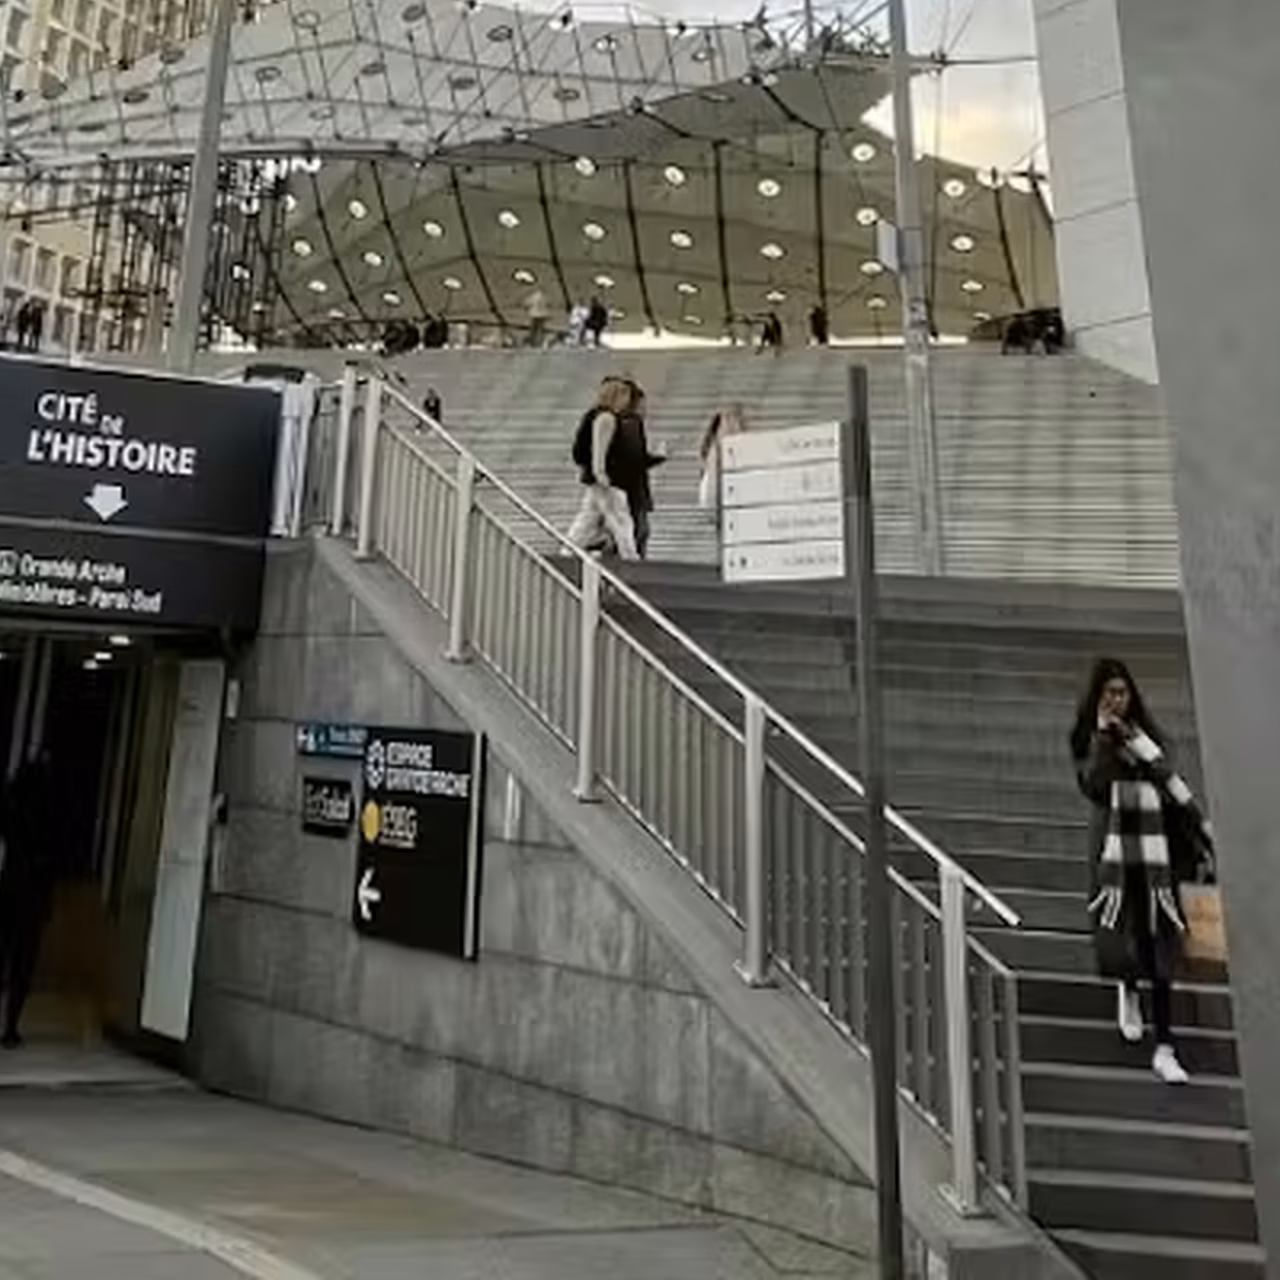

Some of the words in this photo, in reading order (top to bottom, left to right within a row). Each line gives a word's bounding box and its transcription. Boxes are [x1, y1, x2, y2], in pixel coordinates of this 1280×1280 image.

[37, 392, 98, 425] CITÉ
[27, 428, 197, 475] L'HISTOIRE
[21, 552, 76, 580] Grande
[77, 559, 126, 585] Arche
[131, 588, 162, 614] Sud
[386, 741, 433, 769] ESPACE
